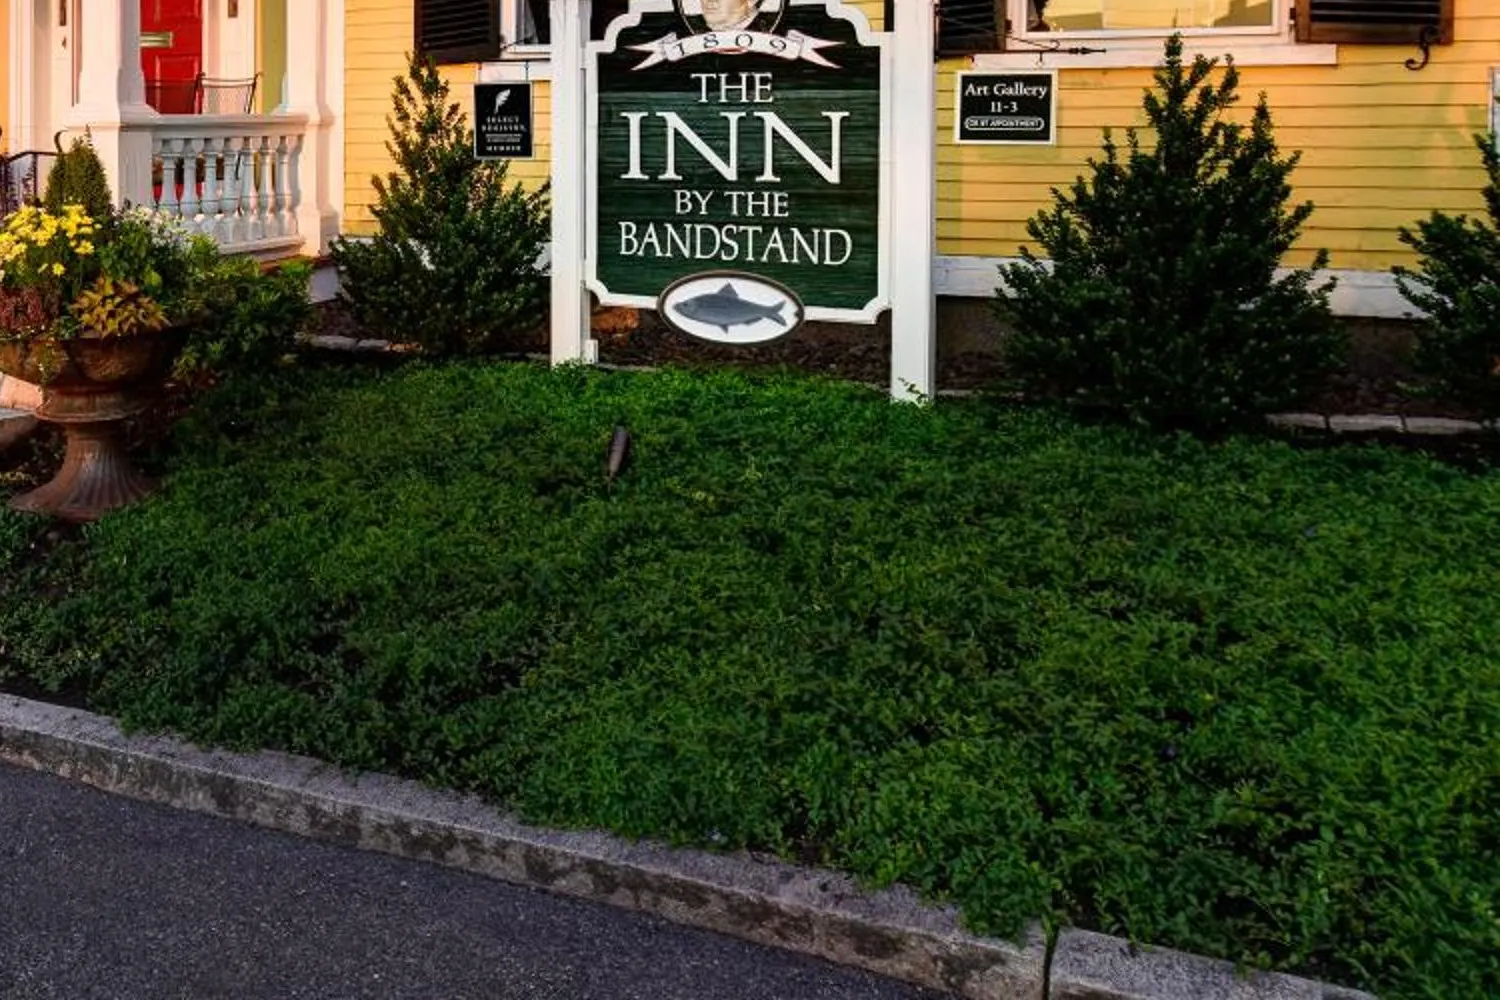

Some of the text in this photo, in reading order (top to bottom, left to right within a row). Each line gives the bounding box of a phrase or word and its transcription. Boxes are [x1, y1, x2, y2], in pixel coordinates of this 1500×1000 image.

[673, 33, 787, 56] 1809
[690, 72, 774, 103] THE
[964, 82, 1047, 99] Art Gallery
[990, 101, 1018, 113] 11-3
[619, 111, 850, 185] INN
[674, 189, 789, 217] BY THE
[618, 221, 853, 265] BANDSTAND
